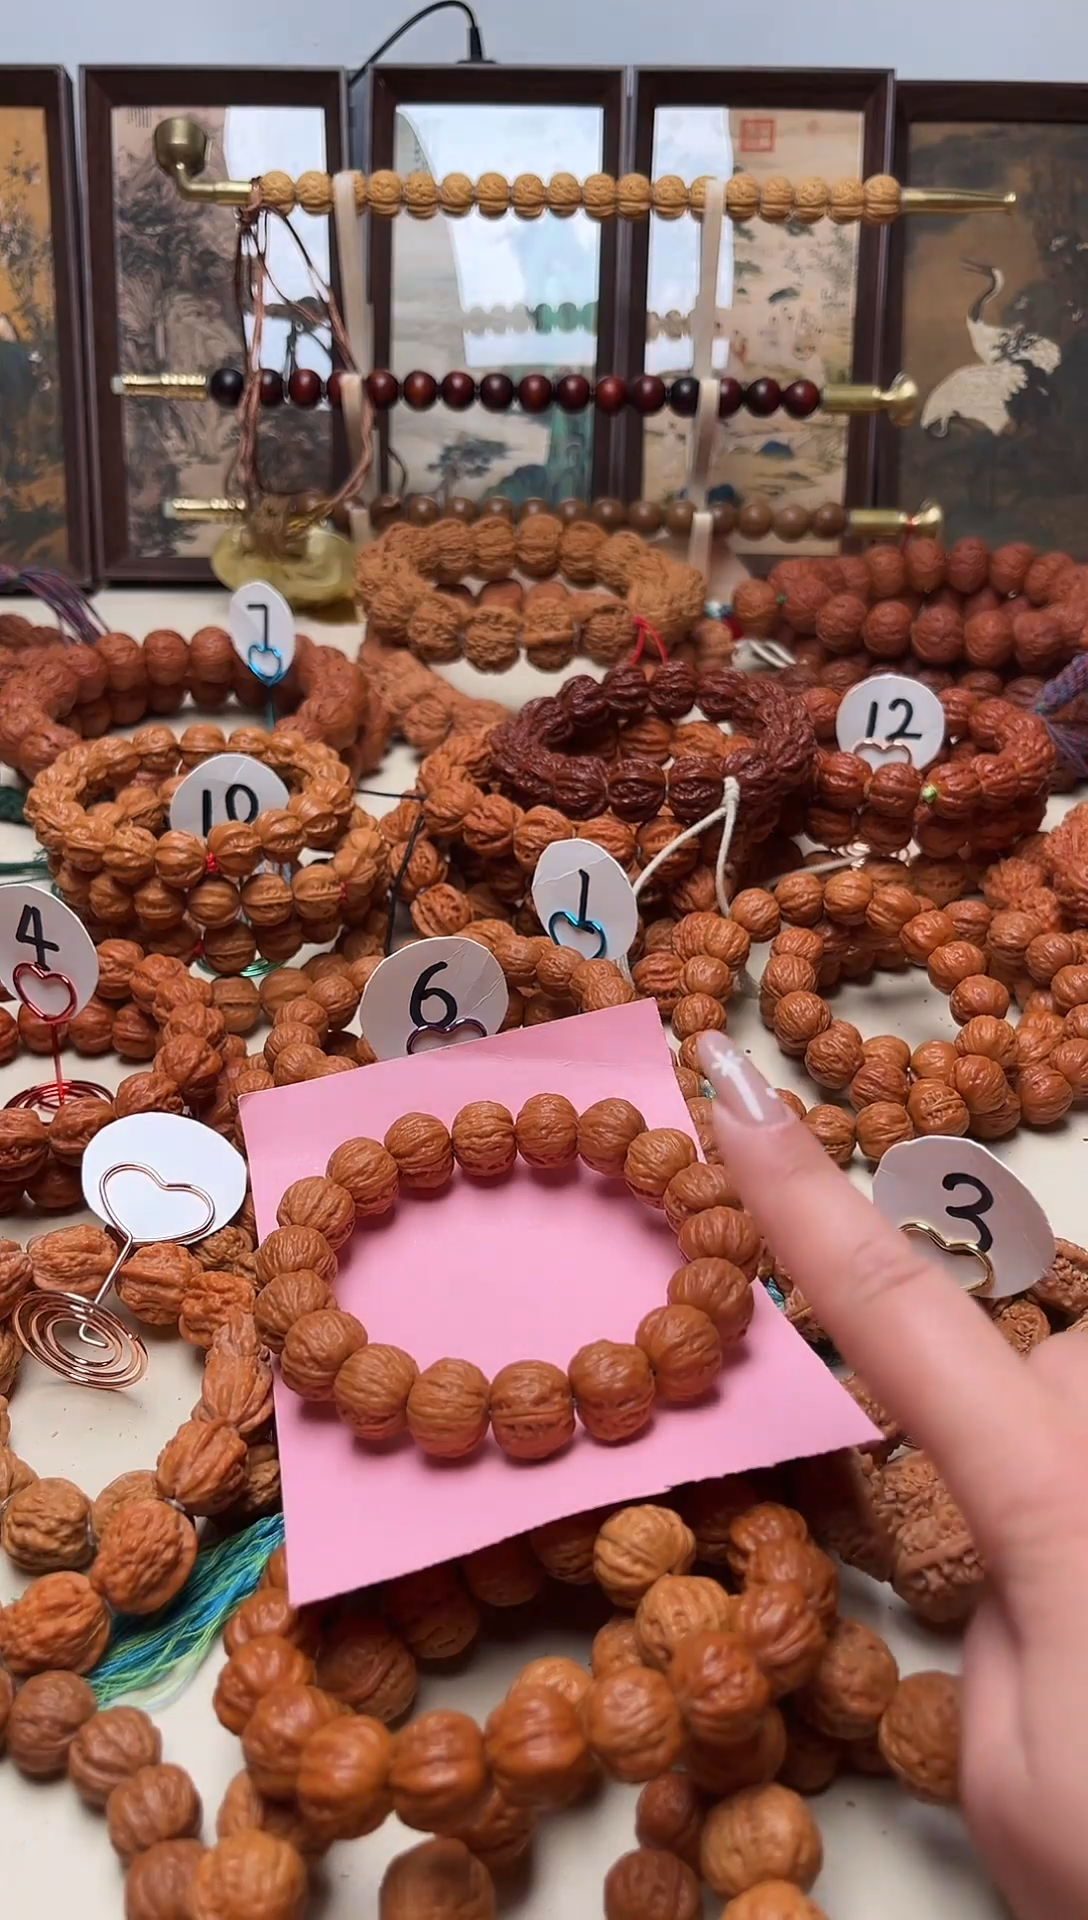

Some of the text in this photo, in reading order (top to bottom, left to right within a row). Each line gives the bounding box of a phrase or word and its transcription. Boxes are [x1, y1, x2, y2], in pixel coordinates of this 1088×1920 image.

[246, 603, 268, 649] 7
[865, 698, 922, 742] 12
[202, 783, 259, 838] 10
[15, 904, 60, 971] 4
[409, 961, 458, 1030] 6
[942, 1172, 994, 1254] 3
